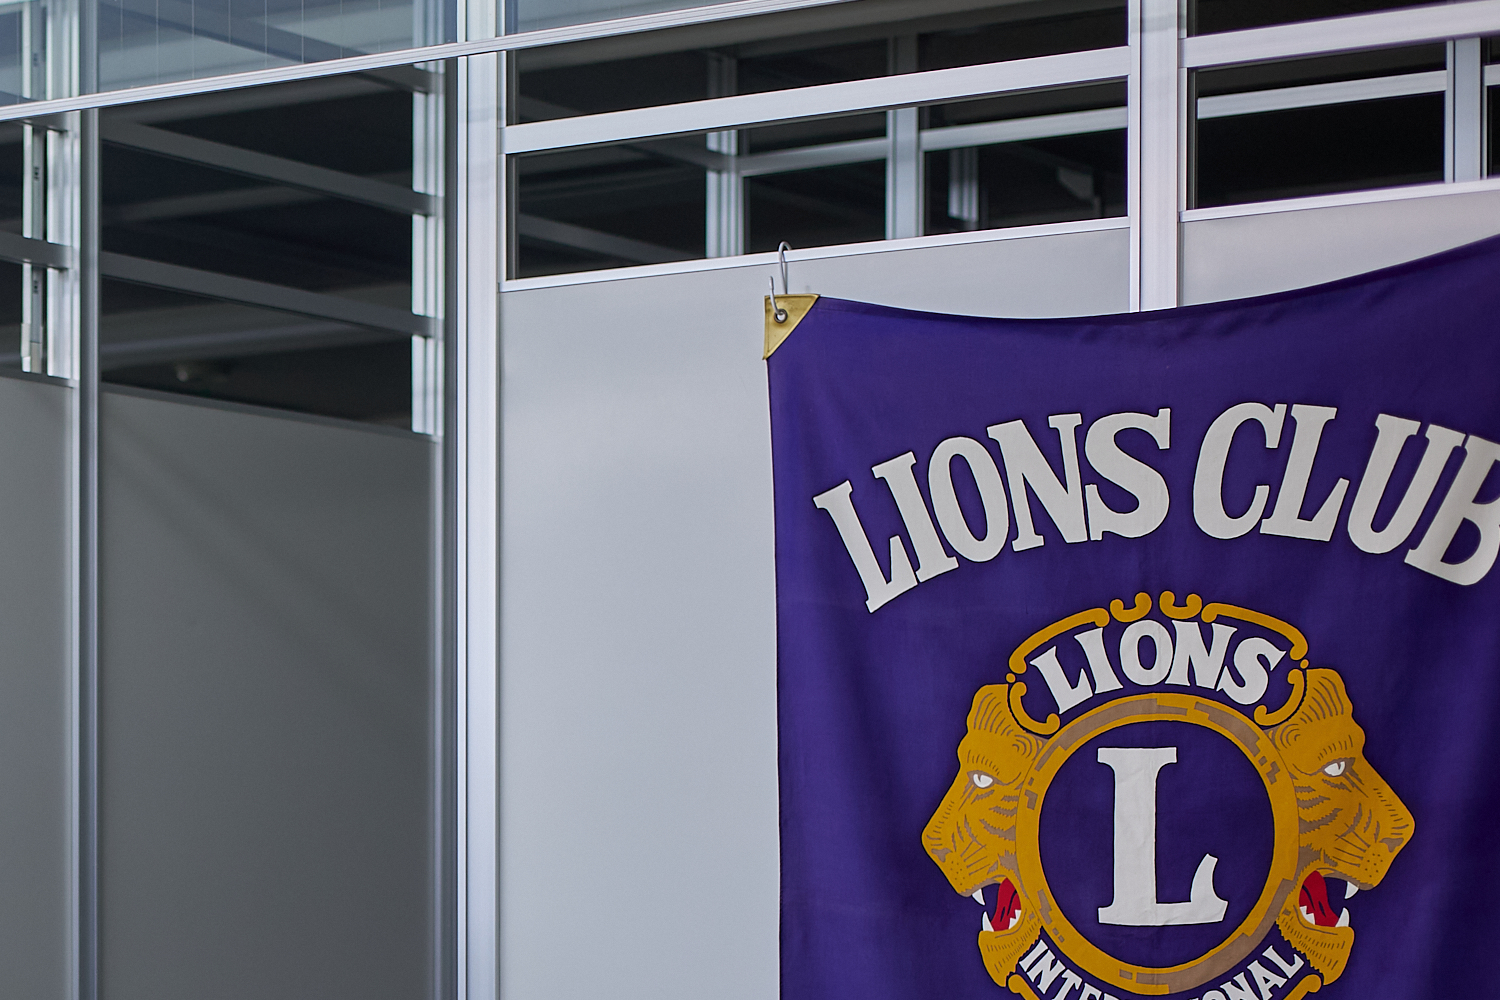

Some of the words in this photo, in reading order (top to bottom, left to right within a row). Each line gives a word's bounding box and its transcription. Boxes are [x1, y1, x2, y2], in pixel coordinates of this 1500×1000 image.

[812, 407, 1172, 614] LIONS
[1192, 401, 1500, 586] CLUB
[1030, 619, 1287, 715] LIONS
[1097, 746, 1229, 927] L
